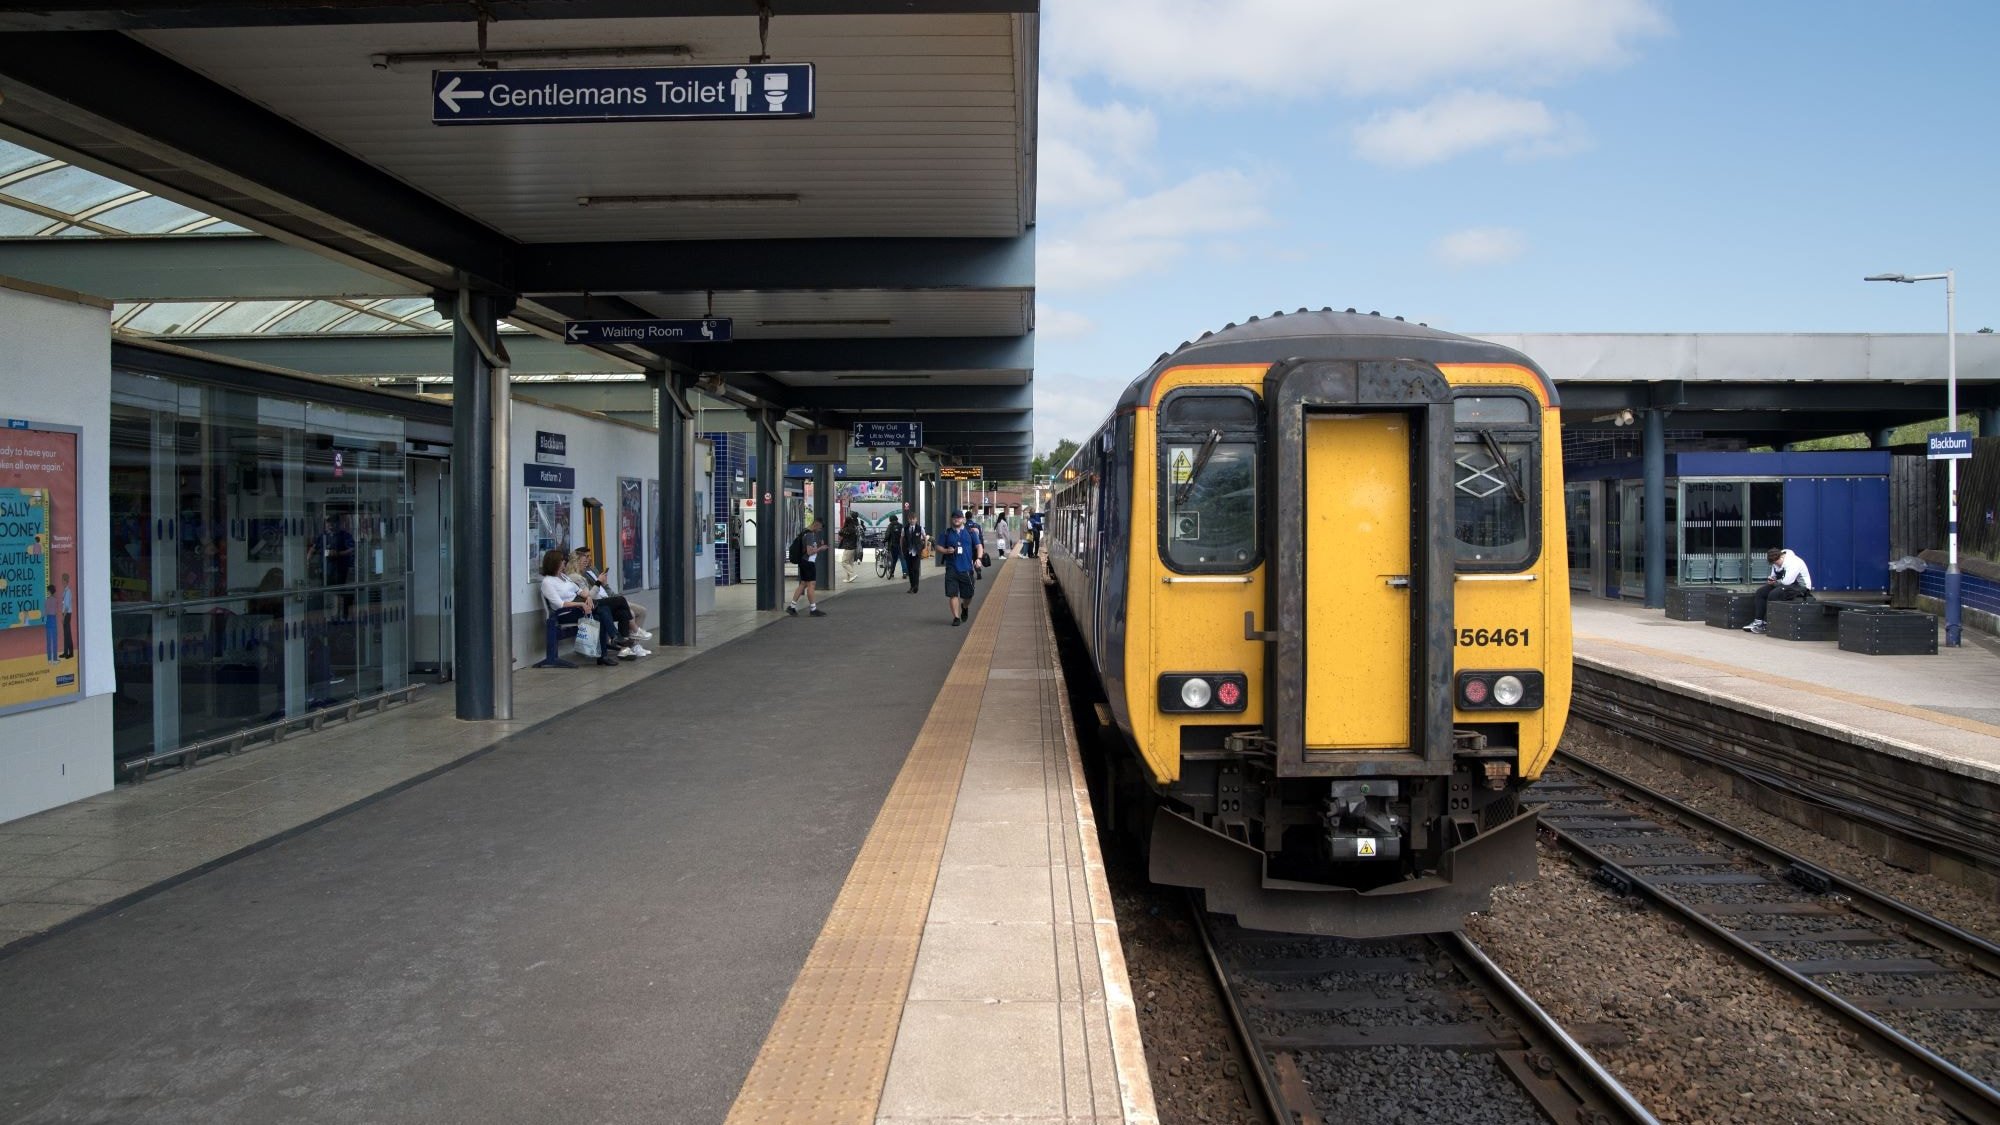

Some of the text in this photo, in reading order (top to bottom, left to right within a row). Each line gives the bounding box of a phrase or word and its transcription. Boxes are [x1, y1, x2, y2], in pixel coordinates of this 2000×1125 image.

[488, 81, 726, 107] Gentlemans Toilet
[601, 326, 683, 339] Waiting Room
[540, 436, 564, 450] Blackburn
[1930, 437, 1967, 449] Blackburn
[15, 447, 22, 456] to
[23, 446, 41, 457] have
[42, 450, 57, 459] your
[0, 459, 14, 469] ken
[14, 460, 24, 469] all
[24, 463, 40, 471] over
[875, 457, 884, 471] 2
[540, 471, 558, 482] Platform
[1, 502, 31, 517] SALLY
[0, 599, 39, 615] RE YOU
